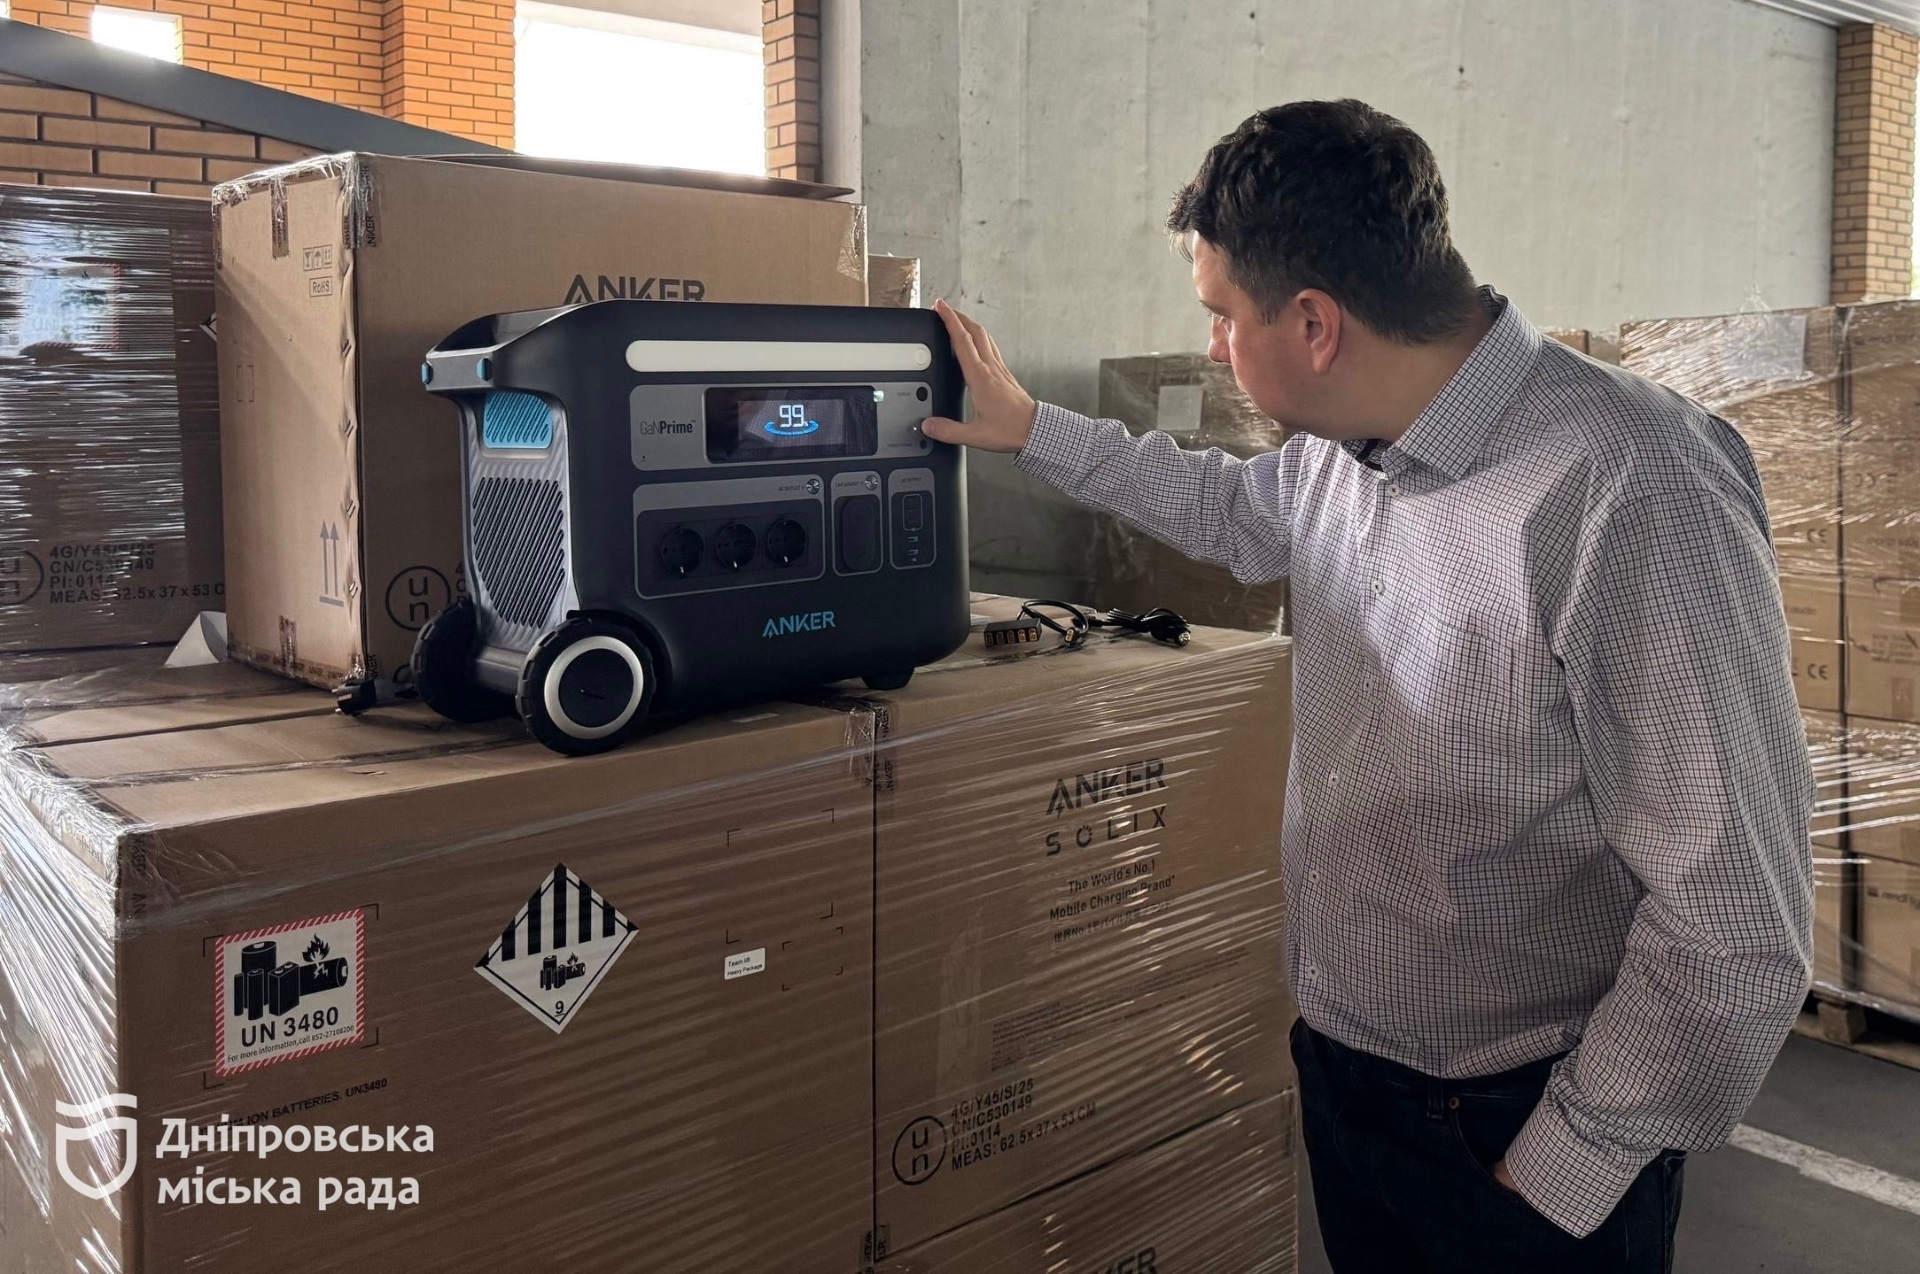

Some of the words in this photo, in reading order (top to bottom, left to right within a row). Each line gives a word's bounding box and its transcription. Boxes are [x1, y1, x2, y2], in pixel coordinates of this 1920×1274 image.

[312, 279, 330, 294] RoHS
[562, 274, 706, 306] ANKER
[214, 582, 226, 595] C
[762, 610, 836, 639] ANKER
[1046, 757, 1167, 819] ANKER
[1068, 878, 1089, 894] The
[1090, 867, 1132, 888] World's
[1050, 901, 1087, 921] Mobile
[554, 1000, 564, 1015] 9
[241, 1020, 276, 1048] UN
[283, 1006, 339, 1037] 3480
[227, 1054, 239, 1063] For
[240, 1049, 258, 1060] more
